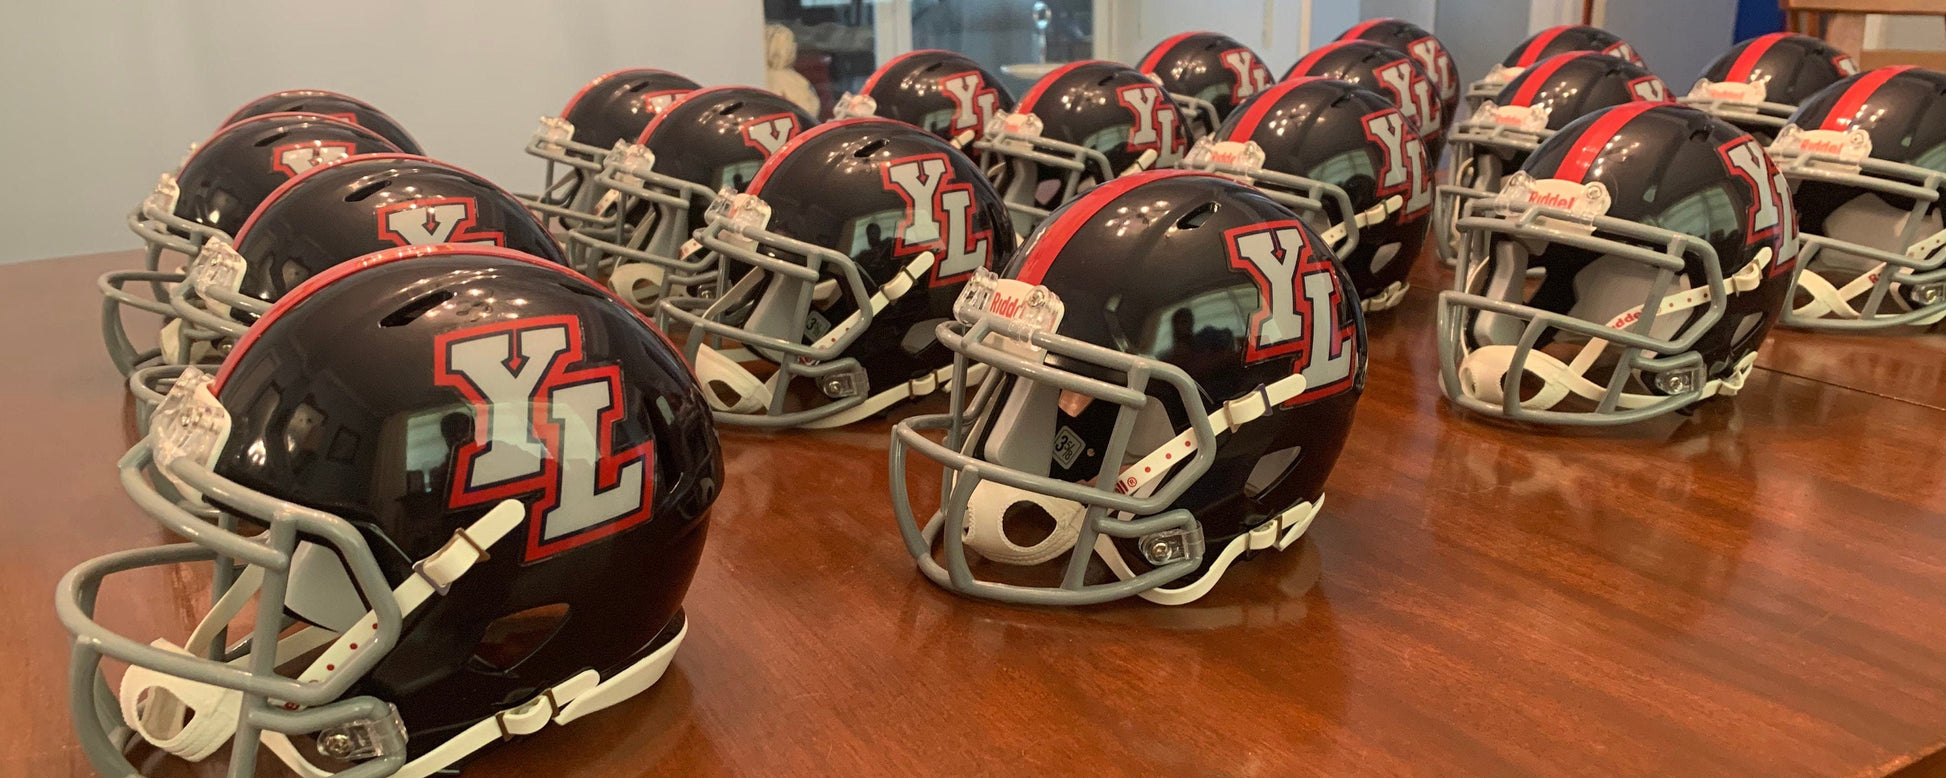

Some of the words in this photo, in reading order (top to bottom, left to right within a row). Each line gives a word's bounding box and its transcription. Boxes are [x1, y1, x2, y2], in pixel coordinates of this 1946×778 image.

[1361, 108, 1434, 224] YL
[1373, 59, 1442, 144] YL
[880, 153, 993, 288] YL
[1718, 134, 1799, 278] YL
[1224, 220, 1355, 407] YL
[434, 315, 654, 562] YL
